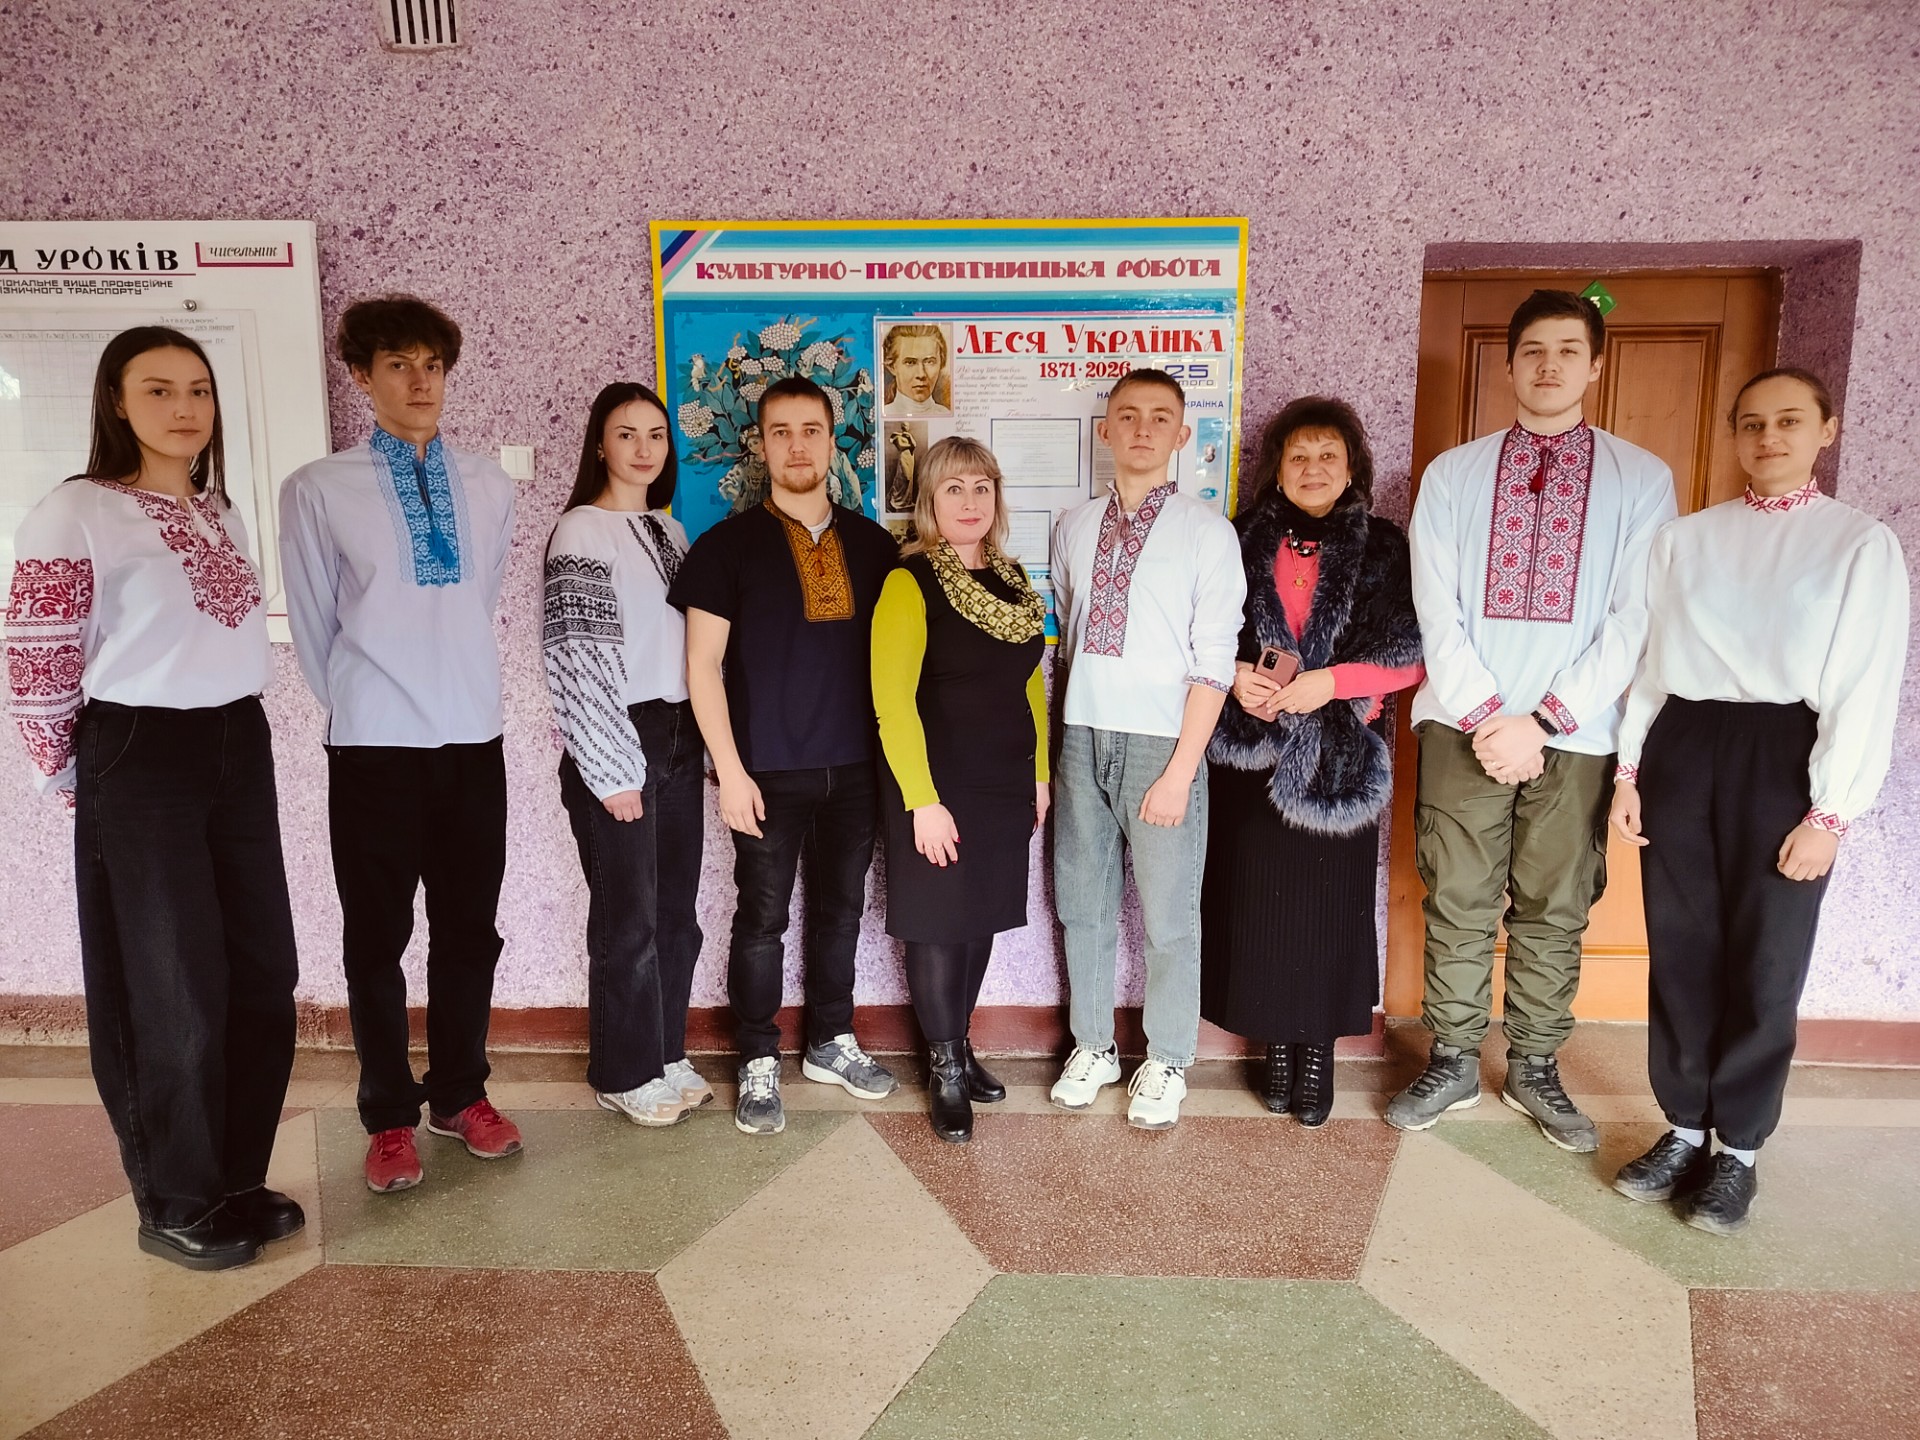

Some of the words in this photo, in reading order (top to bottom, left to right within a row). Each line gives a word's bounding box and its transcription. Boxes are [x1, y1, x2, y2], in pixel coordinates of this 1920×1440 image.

[35, 242, 178, 270] УРОКІВ
[1116, 257, 1221, 278] РОБОТА
[0, 279, 58, 287] ІОНАЛЬНЕ
[101, 279, 173, 288] ПРОФЕСІЙНЕ
[957, 324, 1048, 354] ЛЕСЯ
[1062, 324, 1226, 354] УКРАЇНКА
[1165, 364, 1208, 378] 25
[1184, 399, 1224, 408] КРАЇНКА
